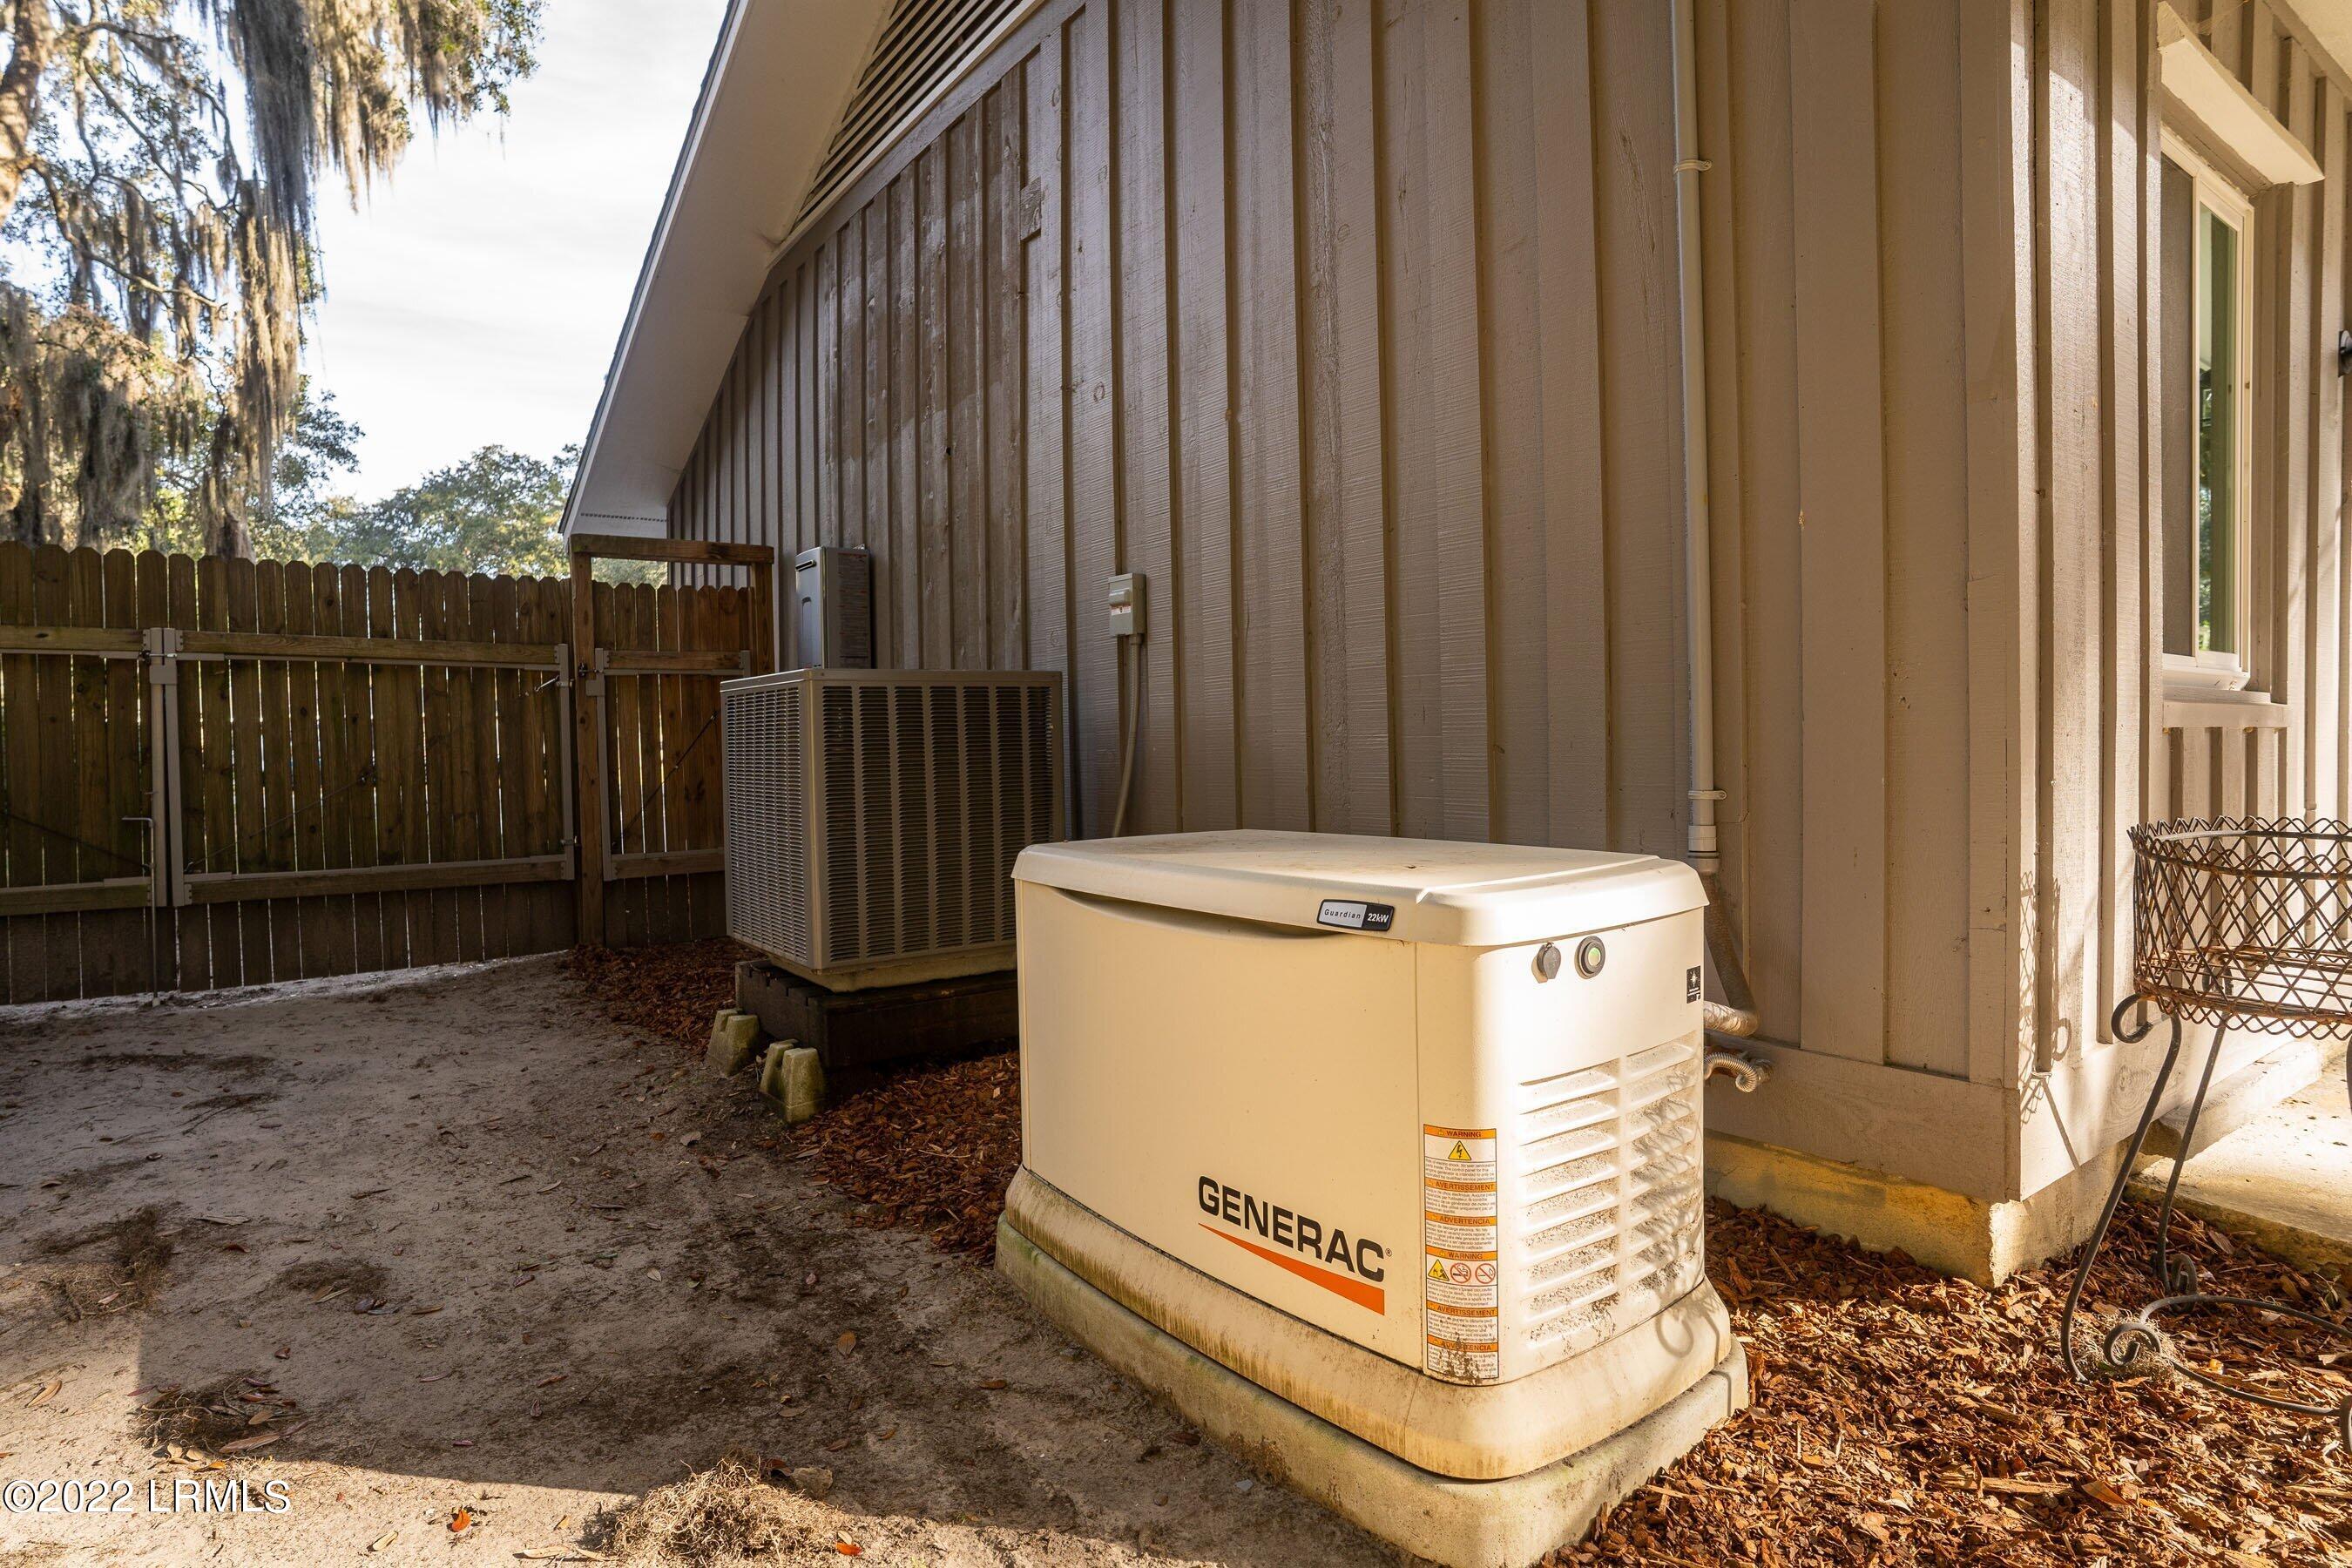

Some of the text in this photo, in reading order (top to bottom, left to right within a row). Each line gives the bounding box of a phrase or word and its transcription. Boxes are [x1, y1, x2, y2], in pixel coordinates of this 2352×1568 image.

[1324, 909, 1389, 923] Guardian 22kW
[1436, 1181, 1493, 1190] AVERTISSEMENT
[1439, 1216, 1490, 1225] ADVERTENCIA
[1199, 1176, 1384, 1282] GENERAC
[1437, 1306, 1495, 1316] AVERTISSEMENT
